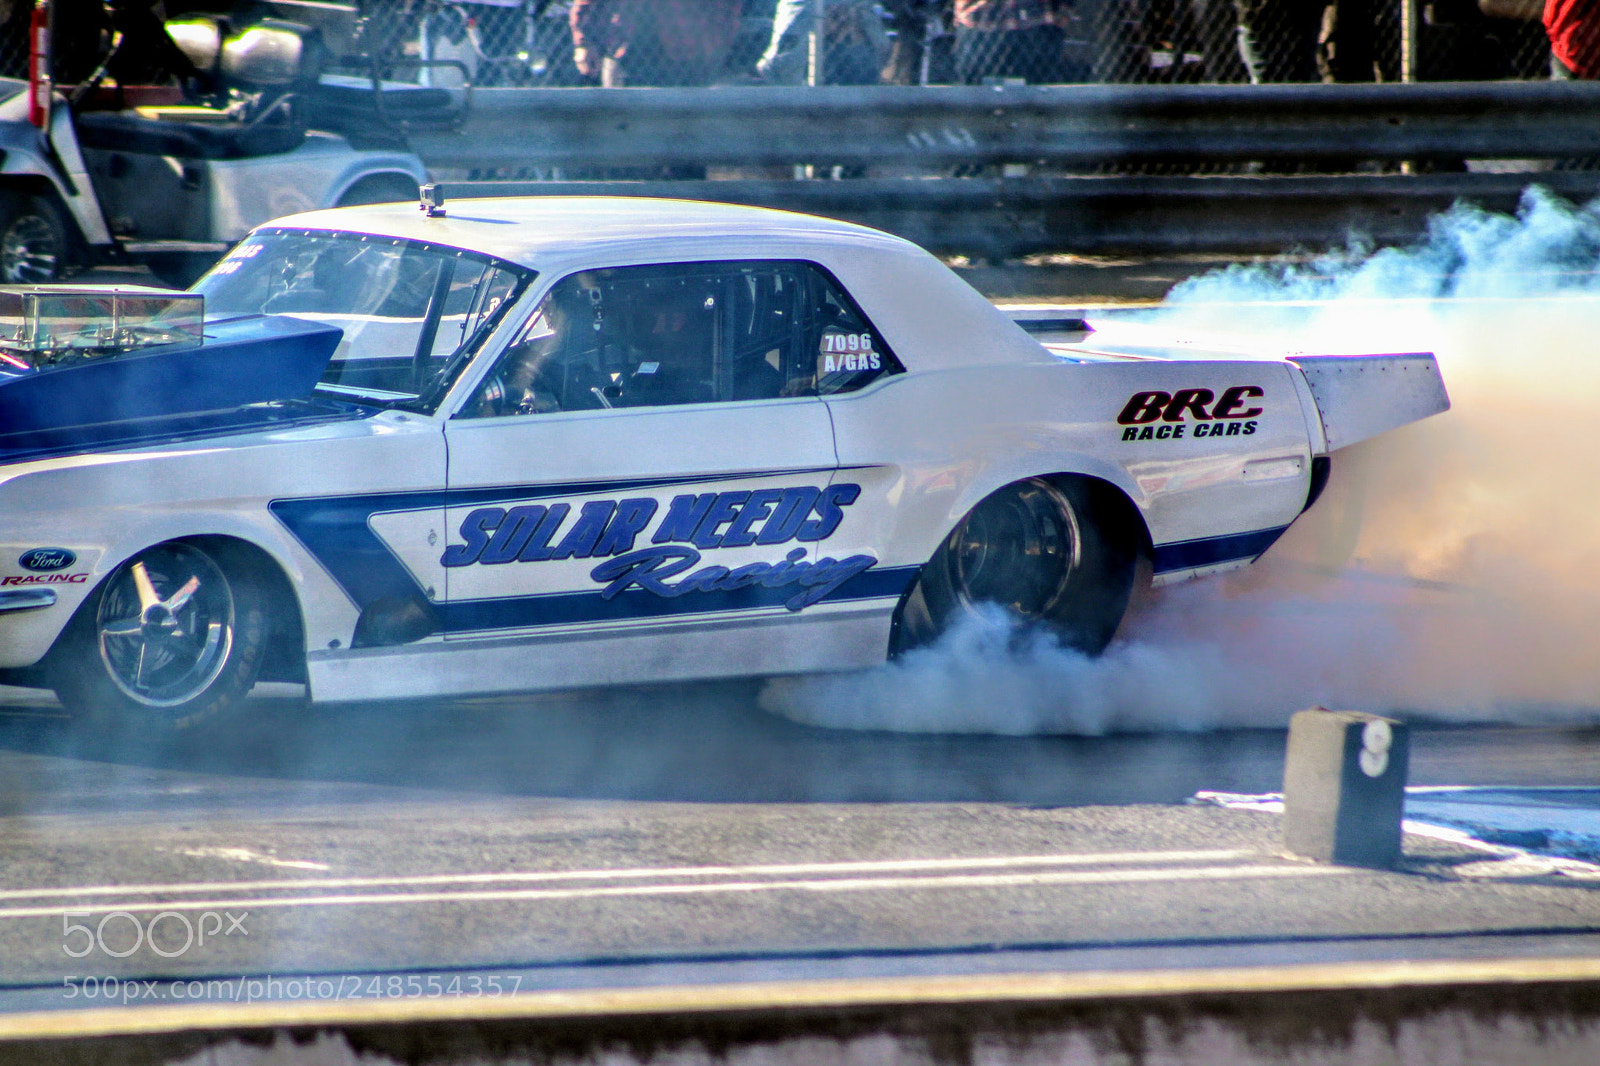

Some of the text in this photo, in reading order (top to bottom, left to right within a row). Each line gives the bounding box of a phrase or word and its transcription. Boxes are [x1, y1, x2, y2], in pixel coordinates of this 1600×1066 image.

[825, 333, 872, 351] 7096
[824, 352, 881, 372] A/GAS
[1117, 385, 1264, 425] BRE
[1121, 420, 1258, 441] RACE CARS
[440, 483, 861, 567] SOLAR NEEDS
[30, 551, 65, 568] Ford
[1, 573, 89, 586] RACING
[590, 545, 878, 612] Racing
